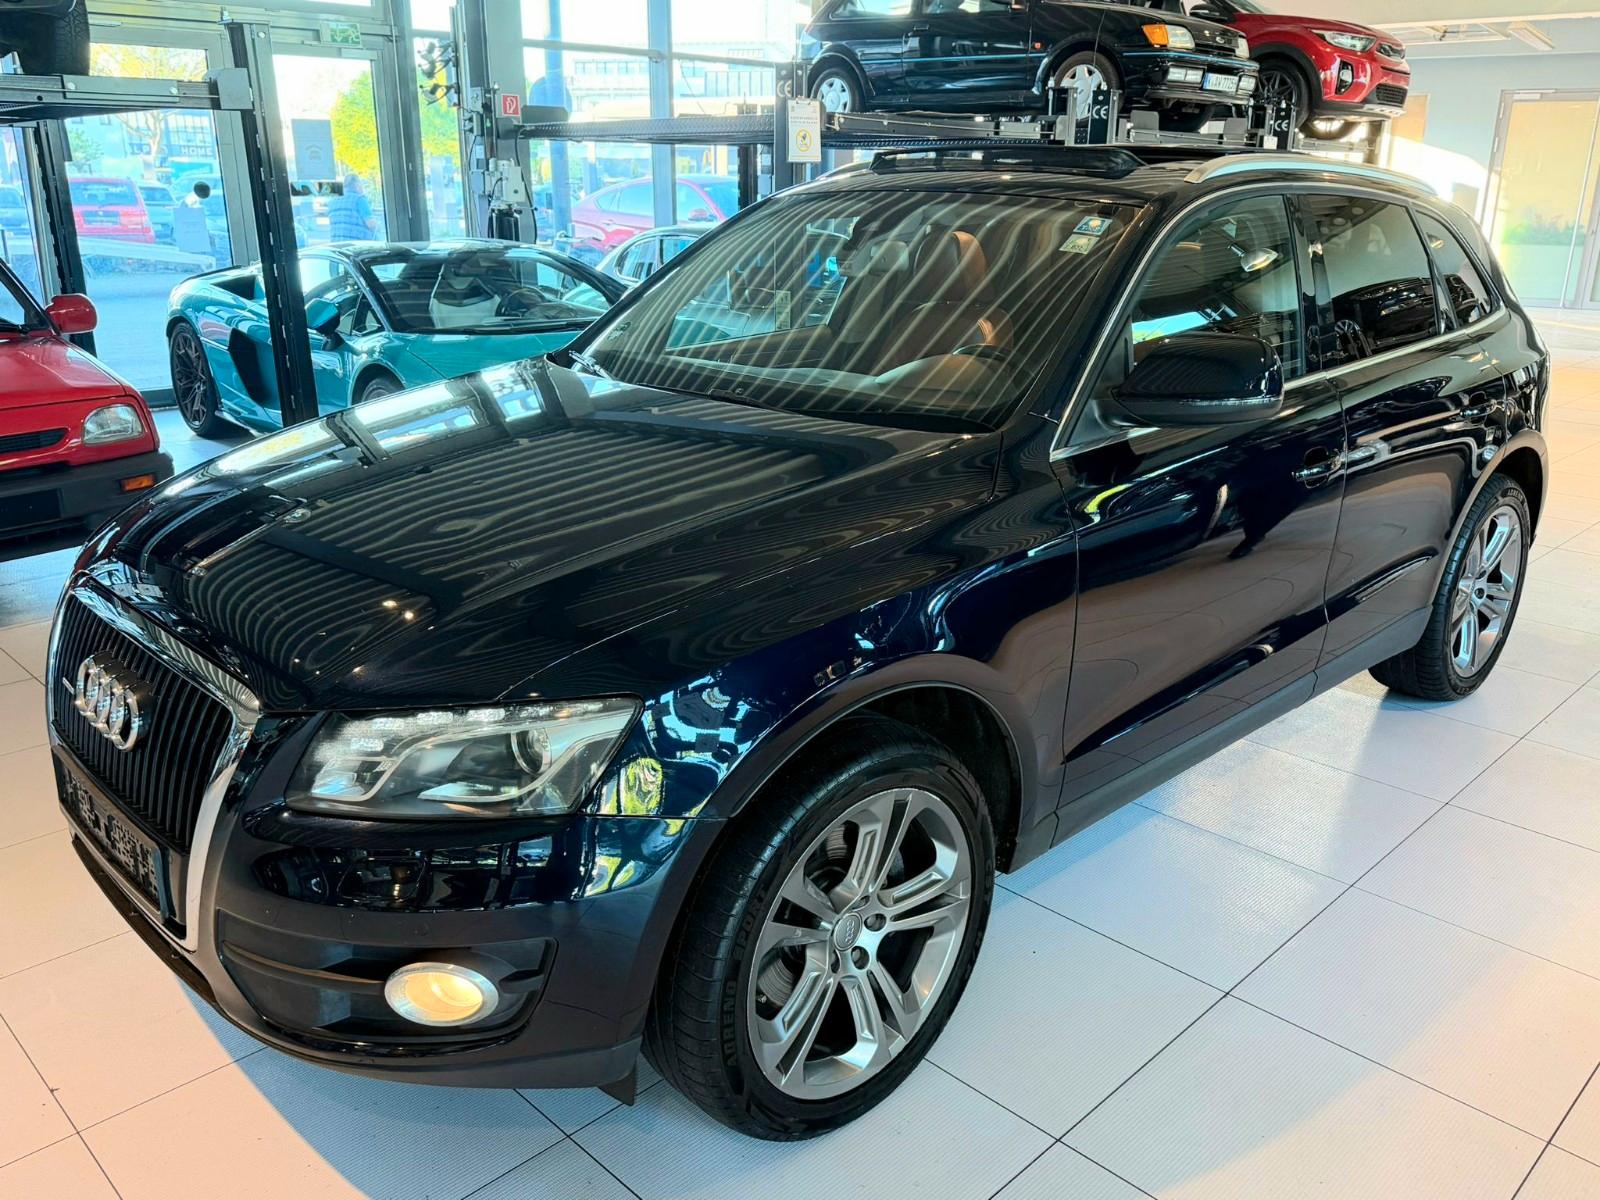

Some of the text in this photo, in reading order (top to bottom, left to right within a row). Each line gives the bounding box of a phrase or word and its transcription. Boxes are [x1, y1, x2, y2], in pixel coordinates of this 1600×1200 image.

[776, 79, 792, 97] CE
[1092, 105, 1109, 119] CE
[1274, 119, 1289, 132] CE
[181, 147, 213, 156] HOME
